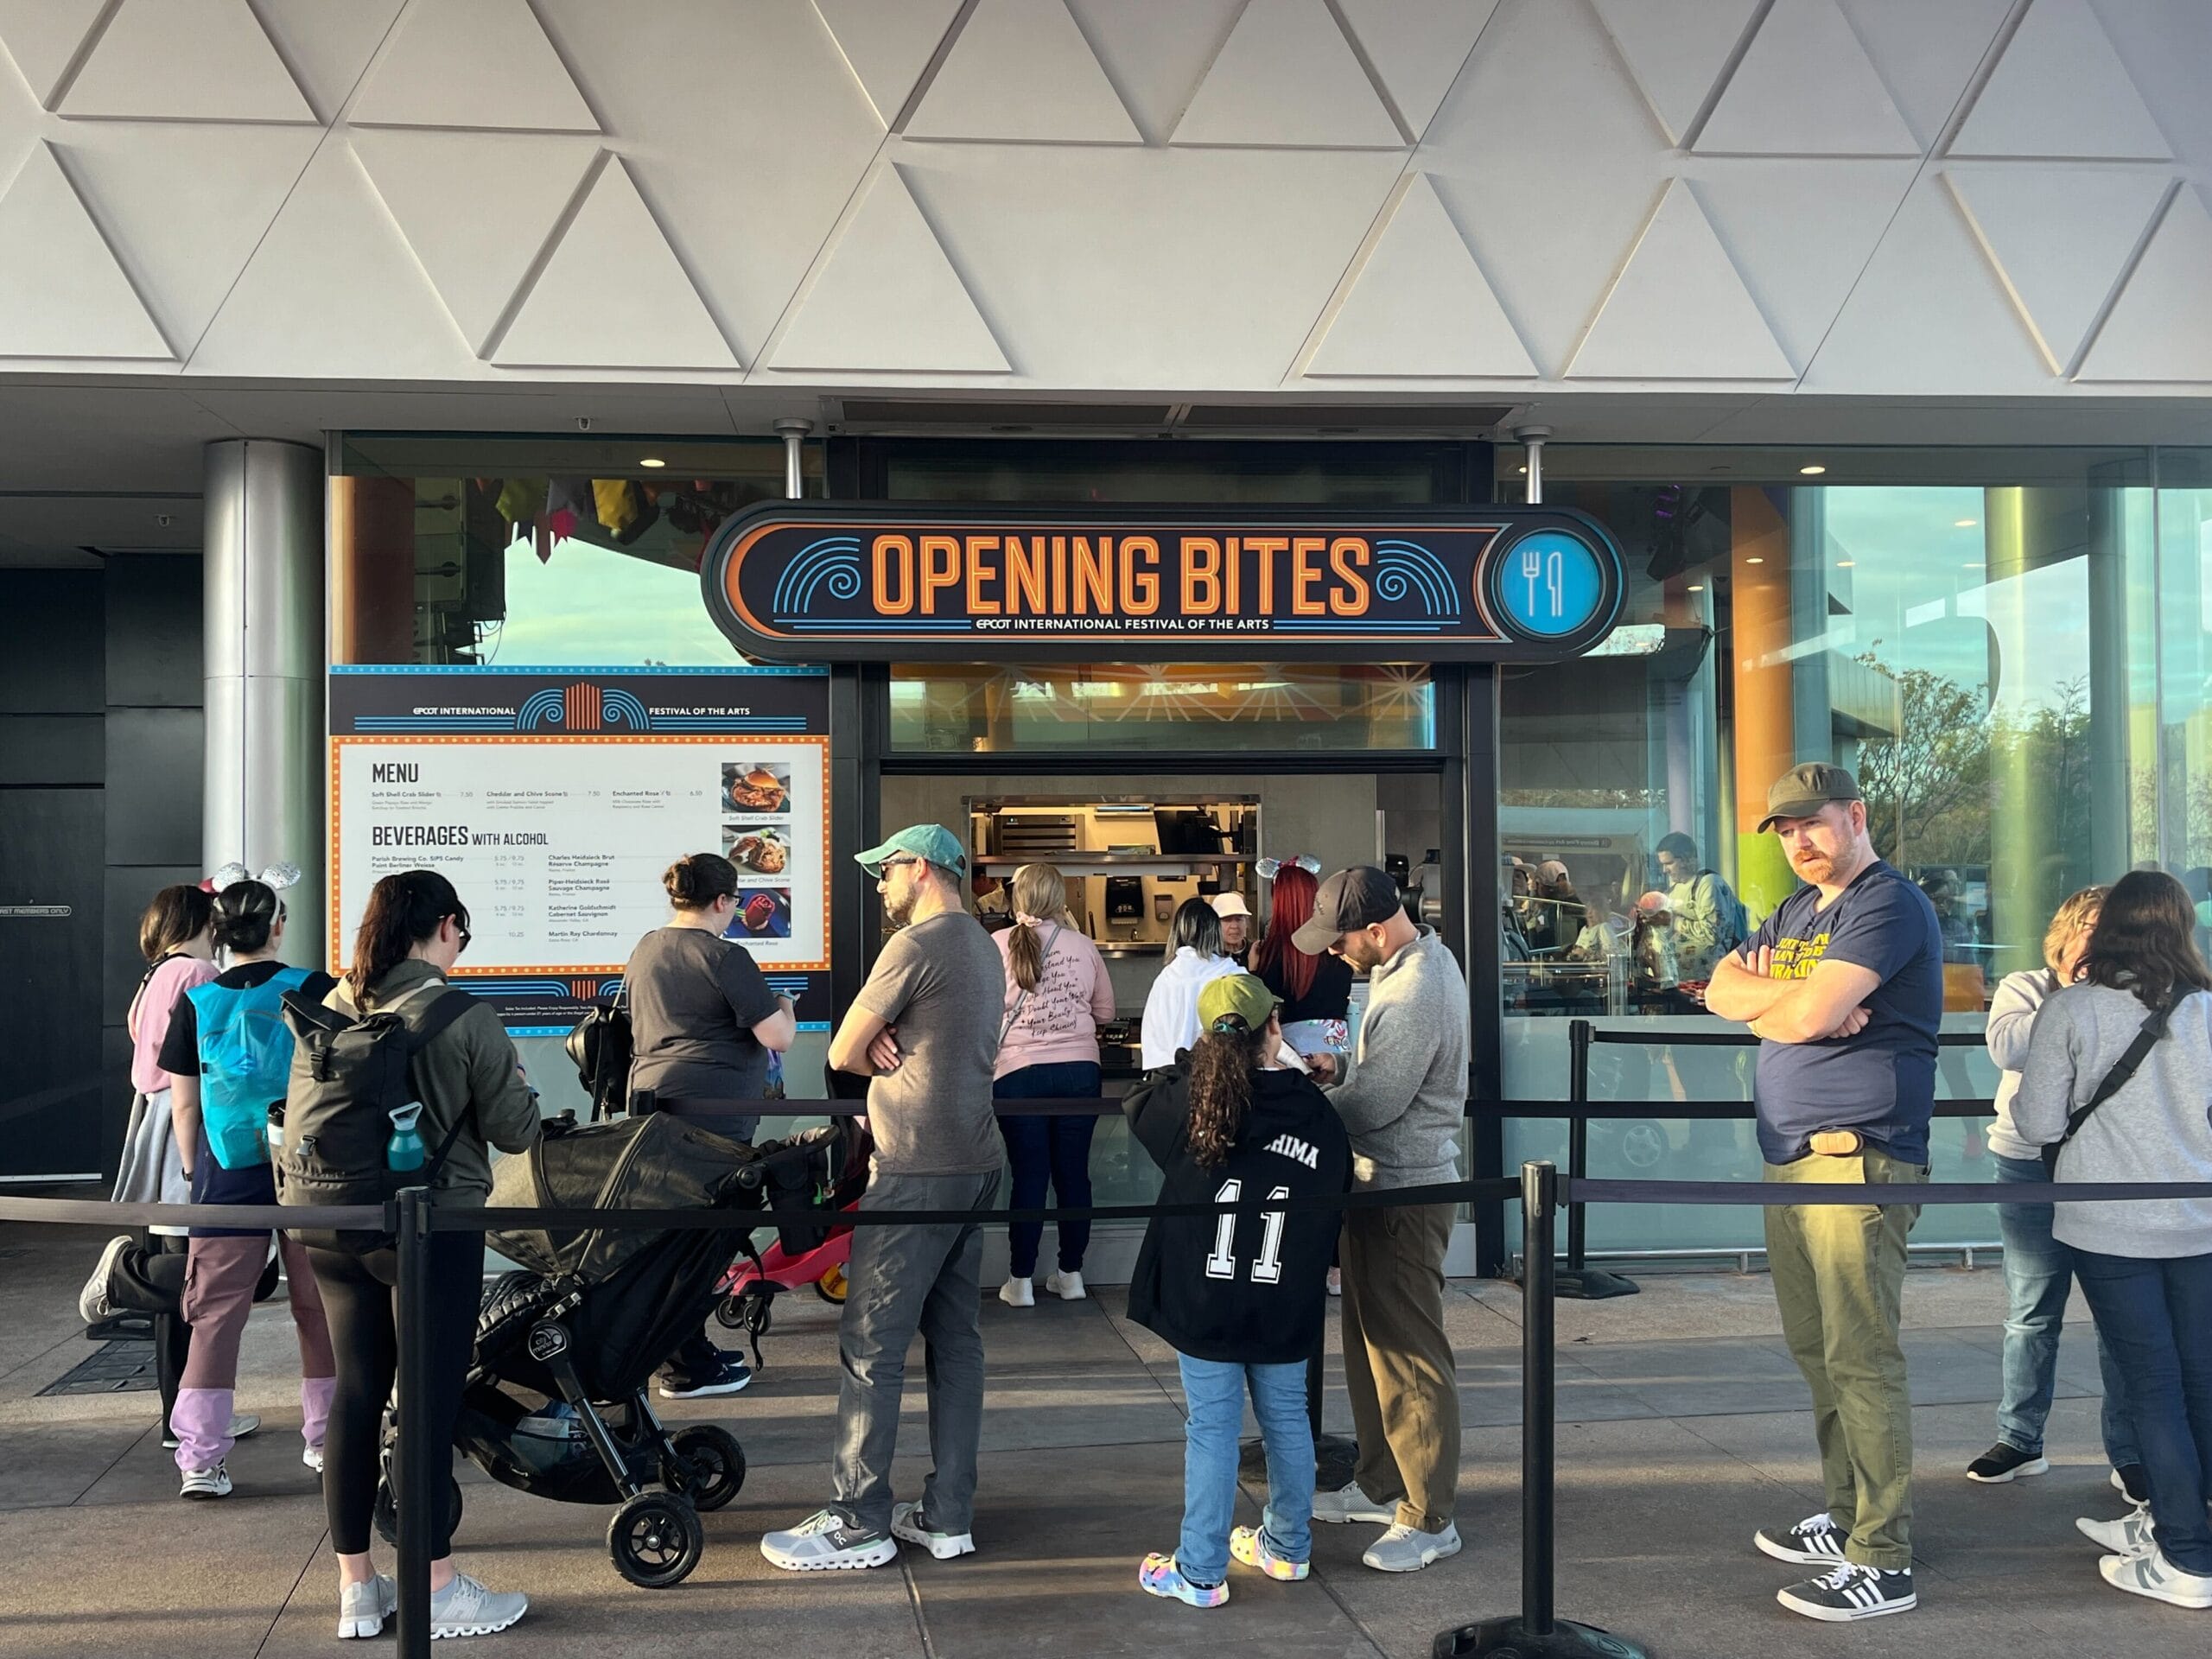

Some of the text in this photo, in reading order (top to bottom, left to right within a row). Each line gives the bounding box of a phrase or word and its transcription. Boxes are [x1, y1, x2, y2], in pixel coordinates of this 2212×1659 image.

[871, 534, 1370, 616] OPENING BITES
[976, 619, 1270, 630] EPCOT INTERNATIONAL FESTIVAL OF THE ARTS
[412, 707, 438, 715] EPCOT
[439, 707, 517, 715] INTERNATIONAL
[372, 763, 419, 783] MENU
[372, 825, 549, 846] BEVERAGES WITH ALCOHOL
[1066, 956, 1080, 968] You
[1051, 970, 1065, 984] You
[1205, 1179, 1289, 1284] 11
